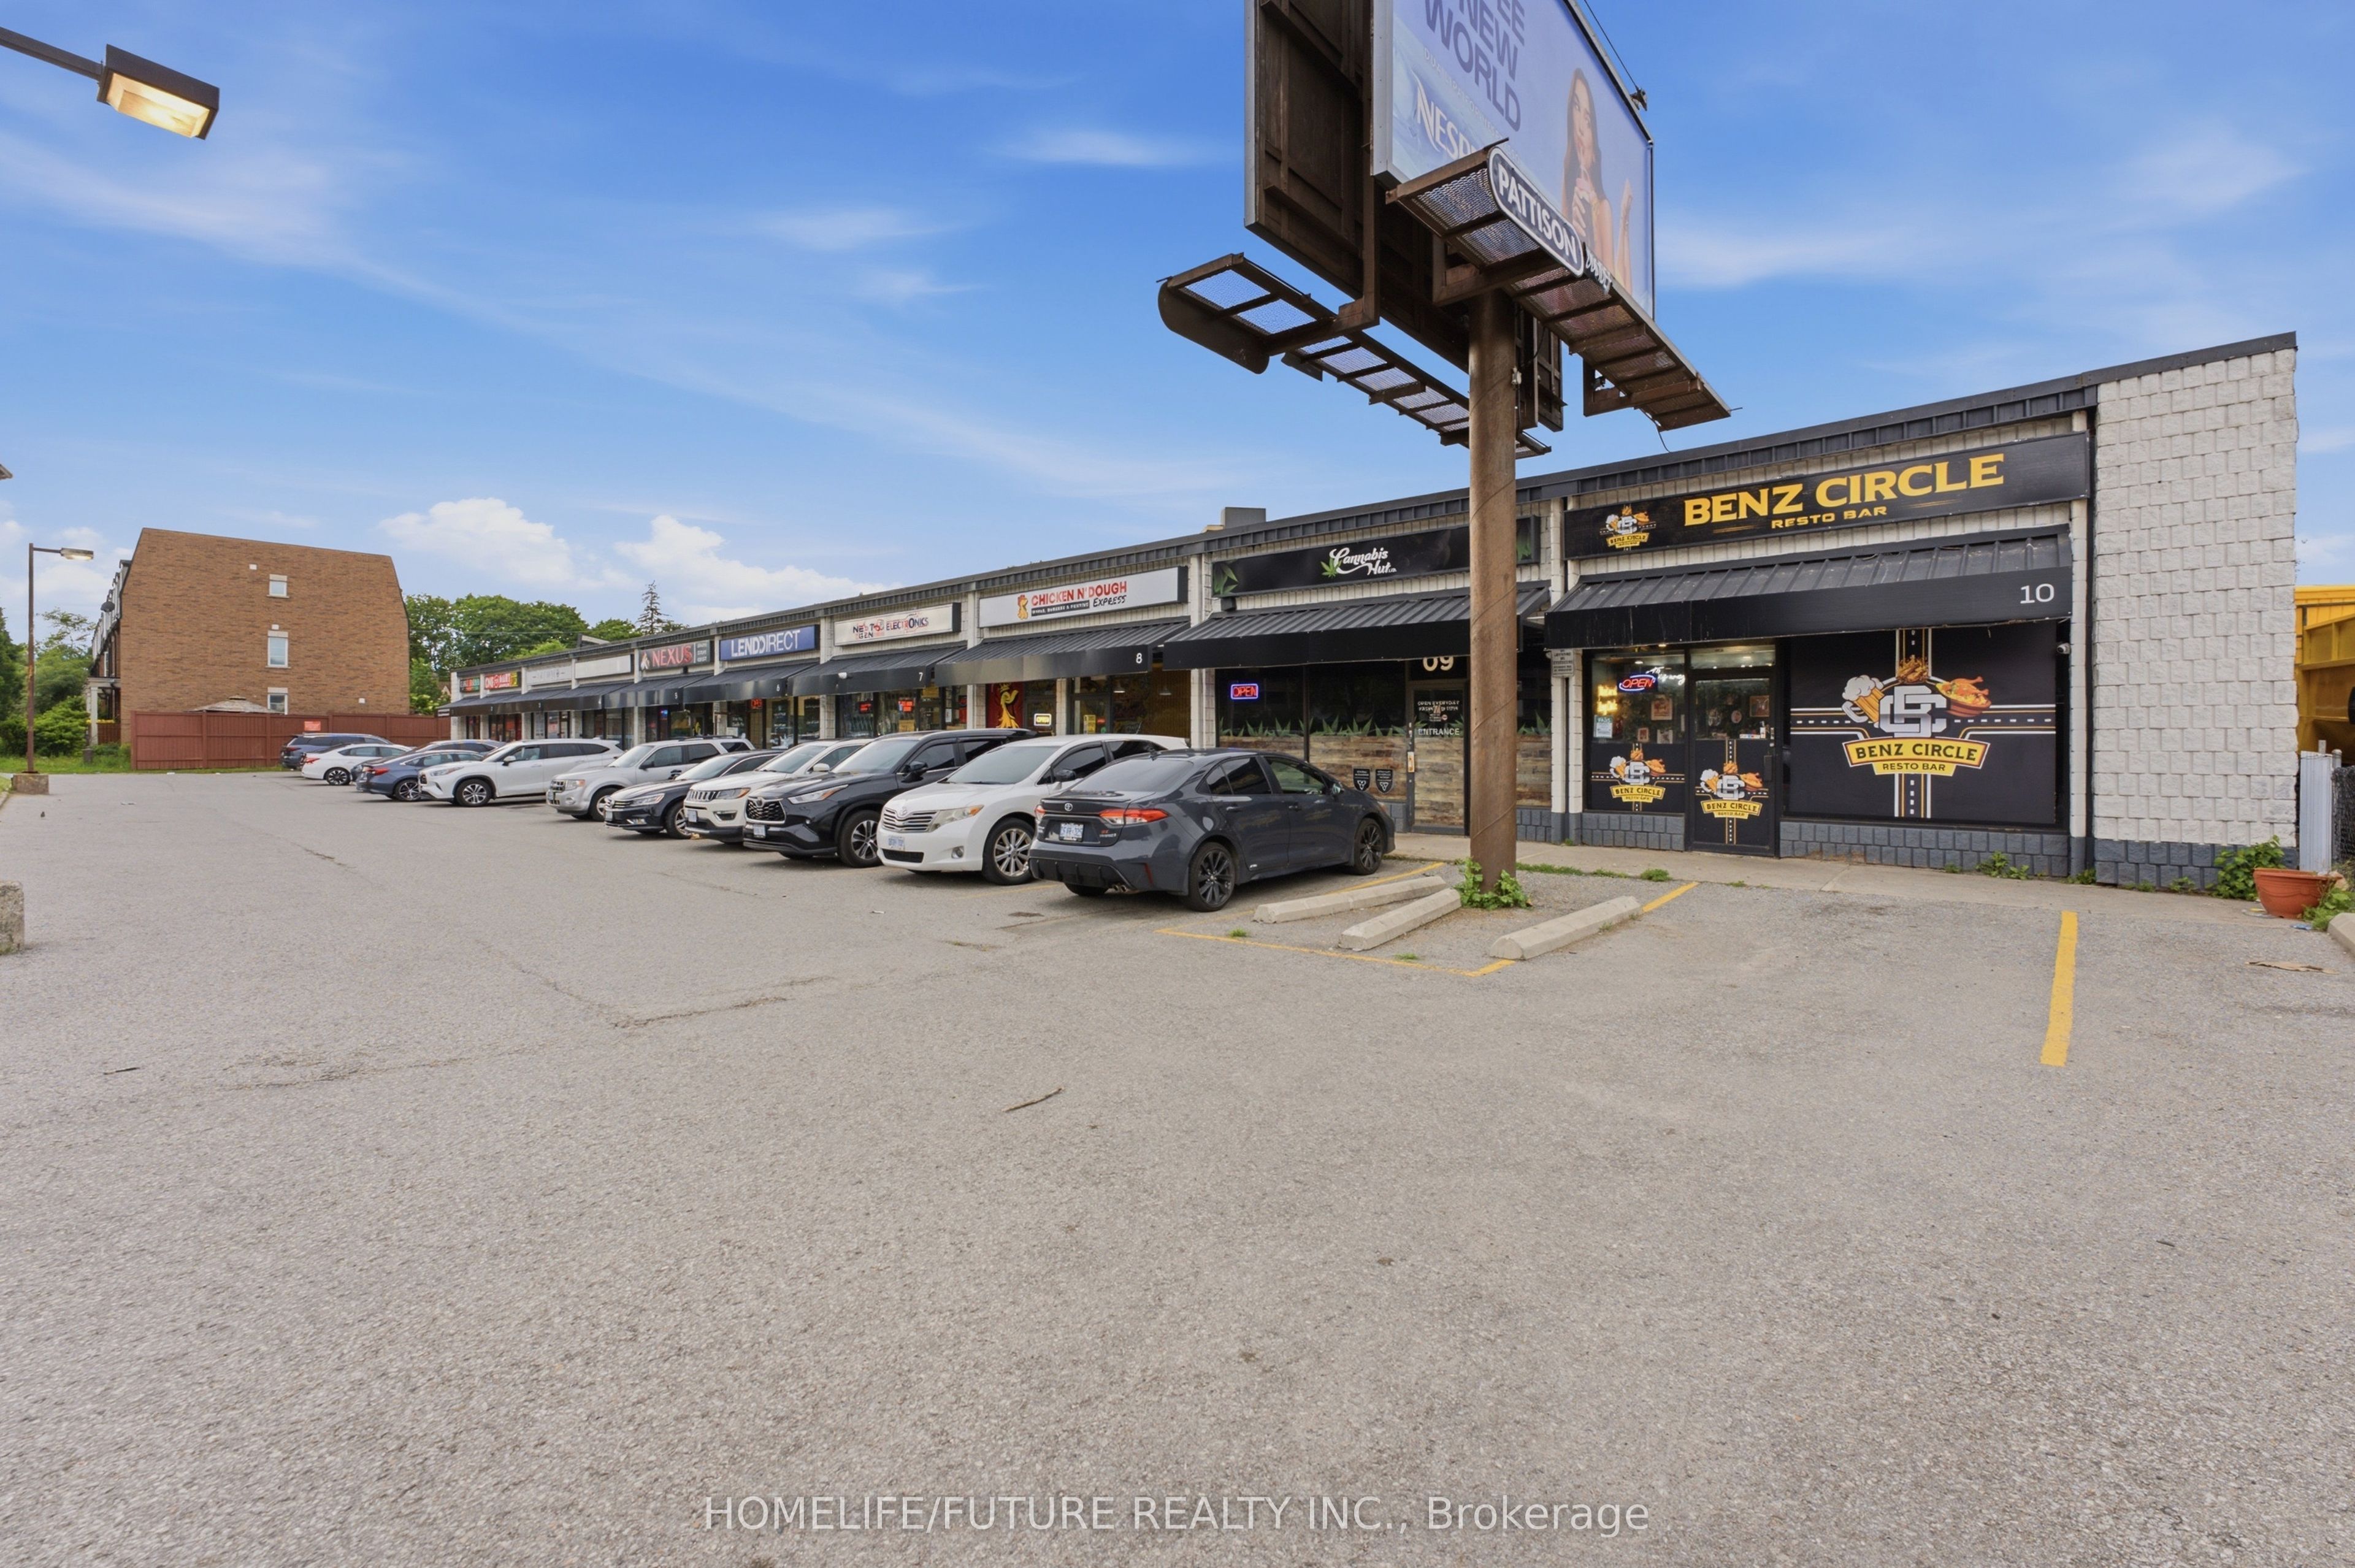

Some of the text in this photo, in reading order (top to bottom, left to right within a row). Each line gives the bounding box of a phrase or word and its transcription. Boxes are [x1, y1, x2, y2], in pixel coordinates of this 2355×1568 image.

[1459, 0, 1518, 82] NEW
[1425, 0, 1521, 132] WORLD
[1412, 71, 1476, 160] NESP
[1498, 163, 1578, 264] PATTISON
[1684, 453, 2004, 527] BENZ CIRCLE
[1771, 506, 1888, 529] RESTO BAR
[1329, 547, 1388, 568] Cannabis
[1367, 559, 1392, 575] Hut
[1031, 589, 1074, 606] CHICKEN
[1093, 595, 1127, 607] EXPRESS
[2020, 583, 2055, 605] 10
[886, 617, 929, 631] ELECTRONICS
[652, 646, 692, 667] NEXUS
[1135, 652, 1143, 664] 8
[1423, 656, 1454, 671] 09
[919, 671, 924, 681] 7
[1622, 678, 1653, 688] OPEN
[1233, 686, 1257, 697] OPEN
[1418, 727, 1460, 736] ENTRANCE
[1855, 743, 1978, 761] BENZ CIRCLE
[1922, 763, 1946, 771] BAR
[1615, 787, 1661, 797] BENZ CIRCLE
[1730, 803, 1758, 813] CIRCLE
